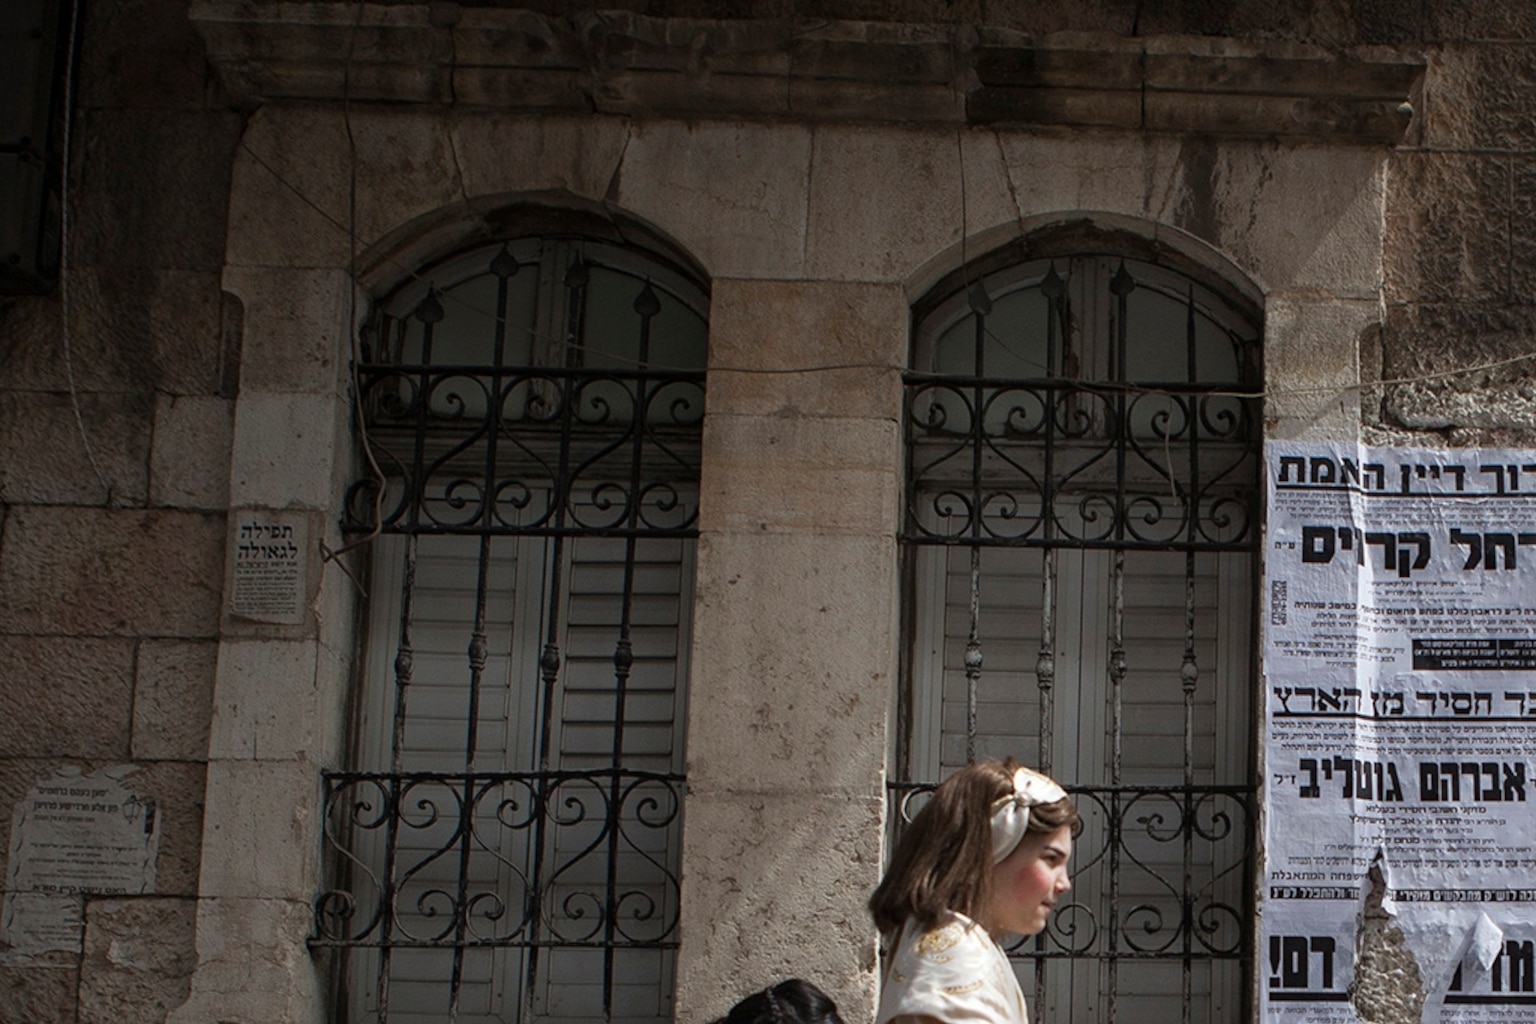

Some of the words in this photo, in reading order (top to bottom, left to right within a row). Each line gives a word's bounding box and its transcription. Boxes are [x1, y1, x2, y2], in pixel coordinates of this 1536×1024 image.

[1278, 455, 1386, 489] האמת
[1400, 464, 1467, 494] דיין
[241, 522, 293, 539] תפילה
[238, 540, 298, 559] לגאולה
[1272, 687, 1362, 713] הארץ
[1370, 689, 1404, 716] מן
[1416, 691, 1492, 715] חסיד
[1299, 754, 1403, 801] גוטליב
[1420, 761, 1526, 801] אברהם
